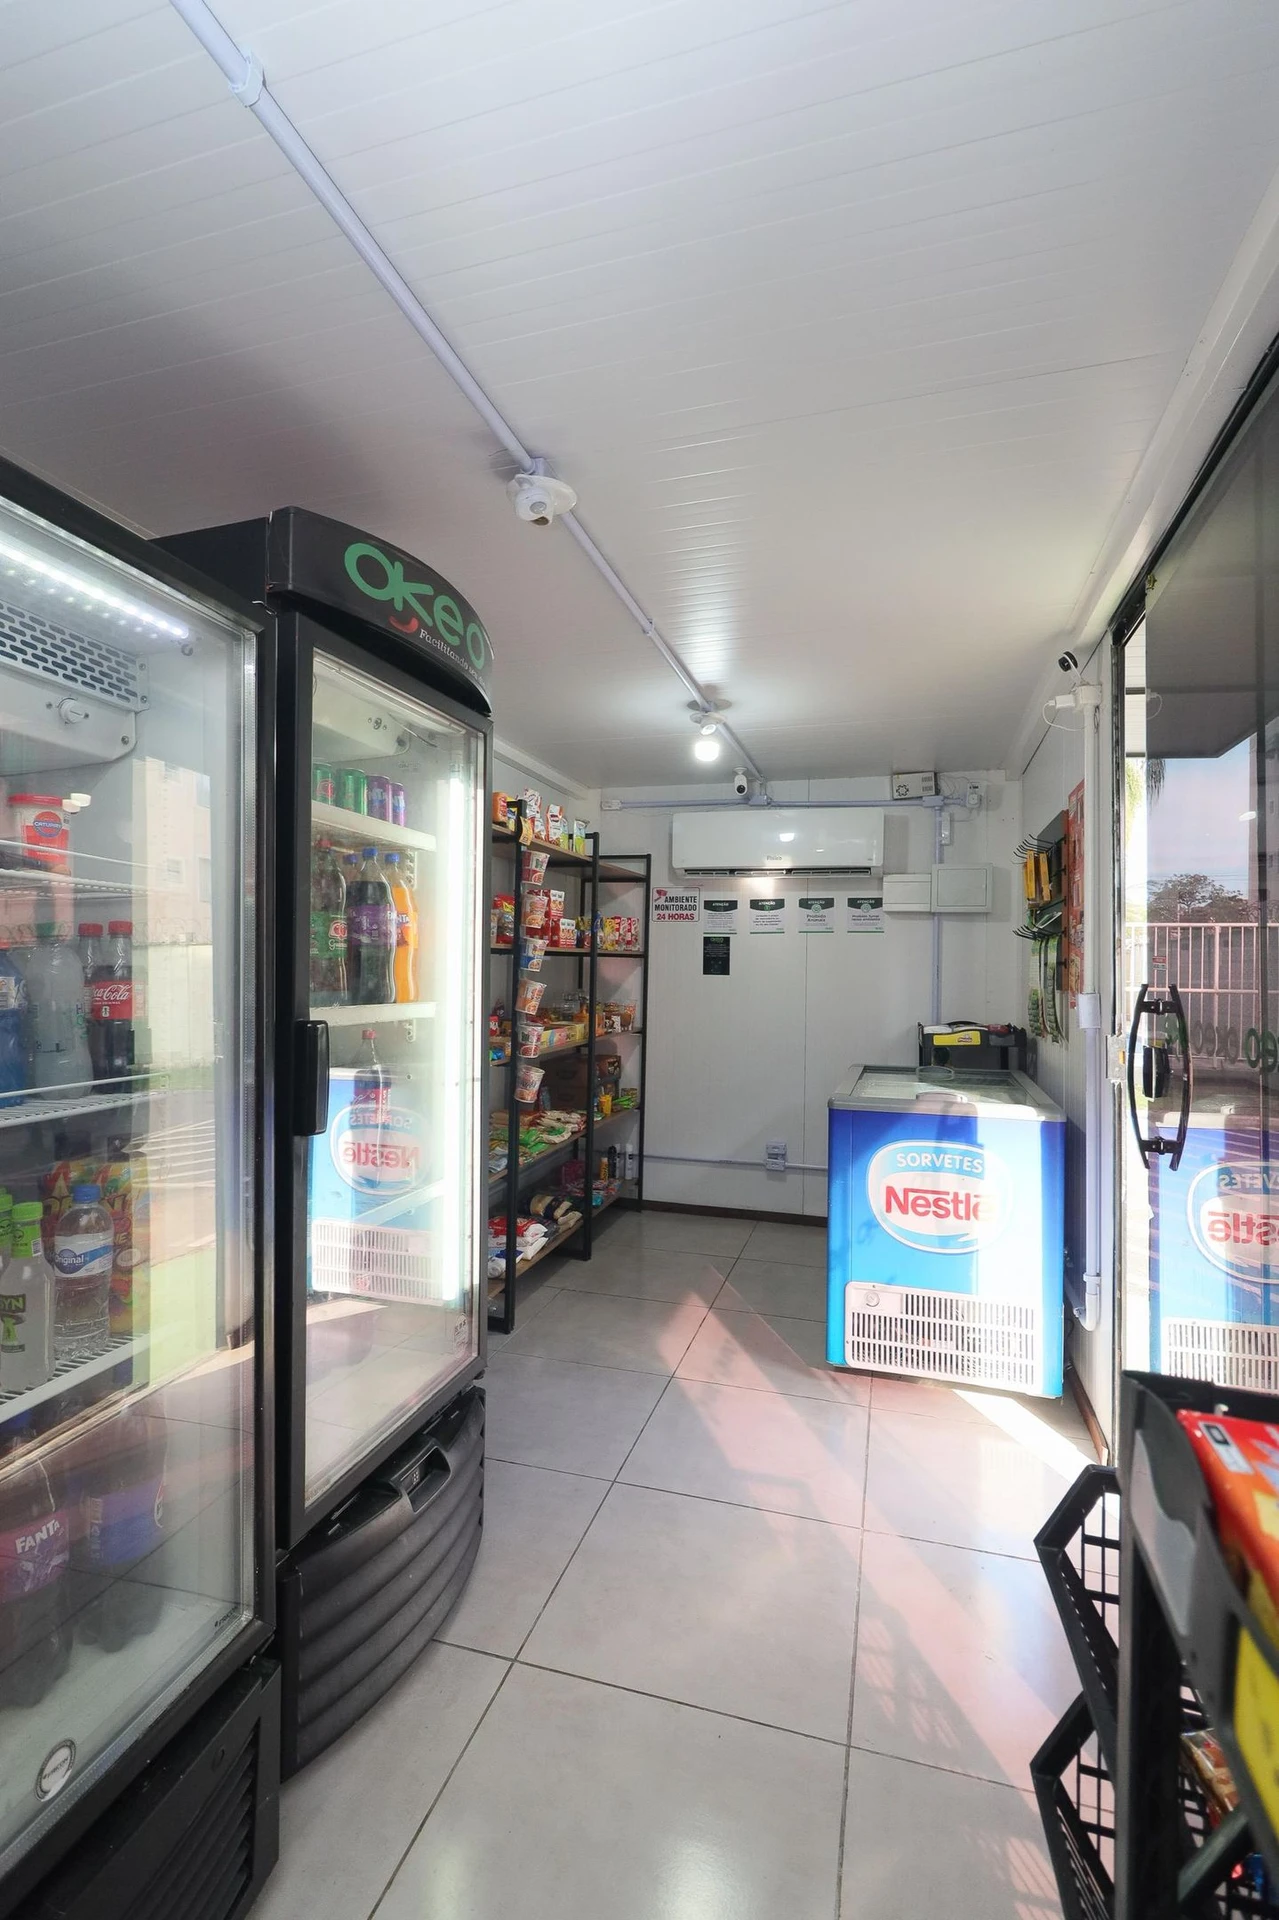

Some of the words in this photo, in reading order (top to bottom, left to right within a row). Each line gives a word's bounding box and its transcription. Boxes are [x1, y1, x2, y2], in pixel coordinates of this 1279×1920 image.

[419, 628, 469, 671] Facilitando
[664, 895, 697, 903] AMBIENTE
[654, 903, 697, 912] MONITORADO
[656, 913, 666, 921] 24
[667, 913, 695, 921] HORAS
[896, 1151, 983, 1173] SORVETES
[55, 1255, 84, 1265] Original
[15, 1519, 60, 1554] FANTA
